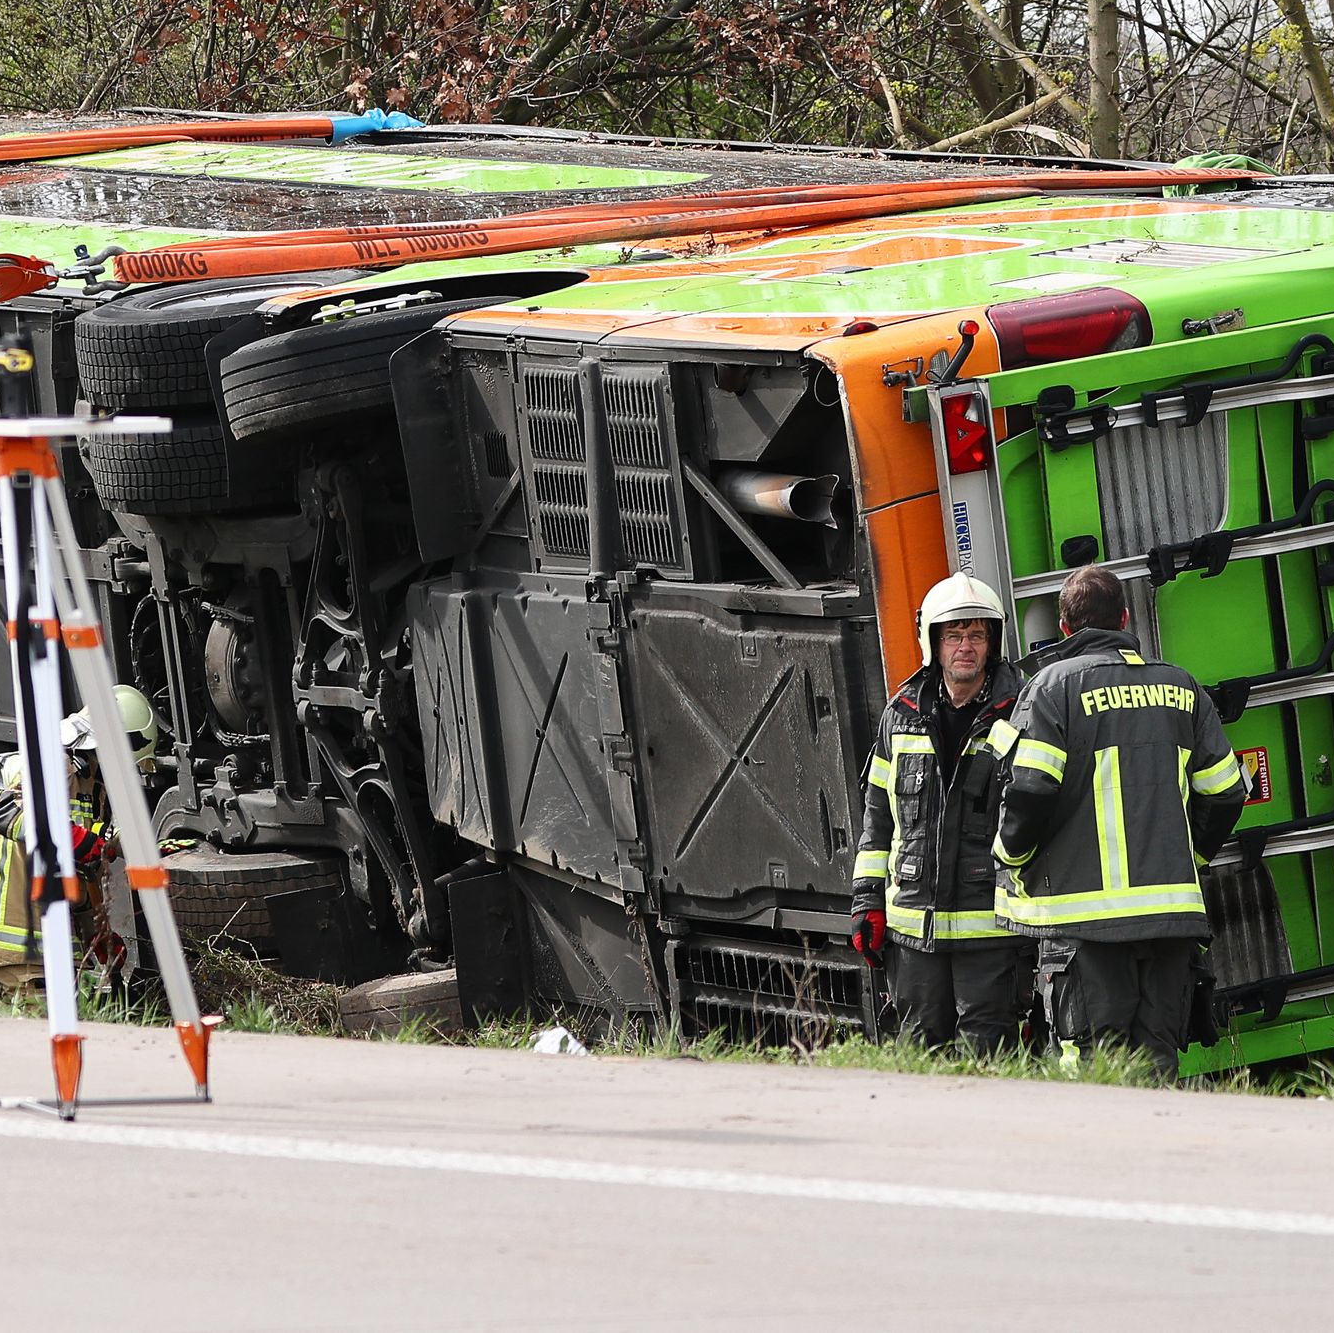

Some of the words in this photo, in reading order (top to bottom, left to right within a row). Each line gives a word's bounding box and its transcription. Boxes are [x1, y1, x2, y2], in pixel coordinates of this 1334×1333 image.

[352, 238, 401, 260] WLL
[401, 230, 490, 254] 10000KG
[118, 251, 209, 282] 10000KG
[953, 504, 974, 578] HUCKEPAC
[1080, 684, 1195, 717] FEUERWEHR
[1258, 750, 1270, 799] ATTENTION
